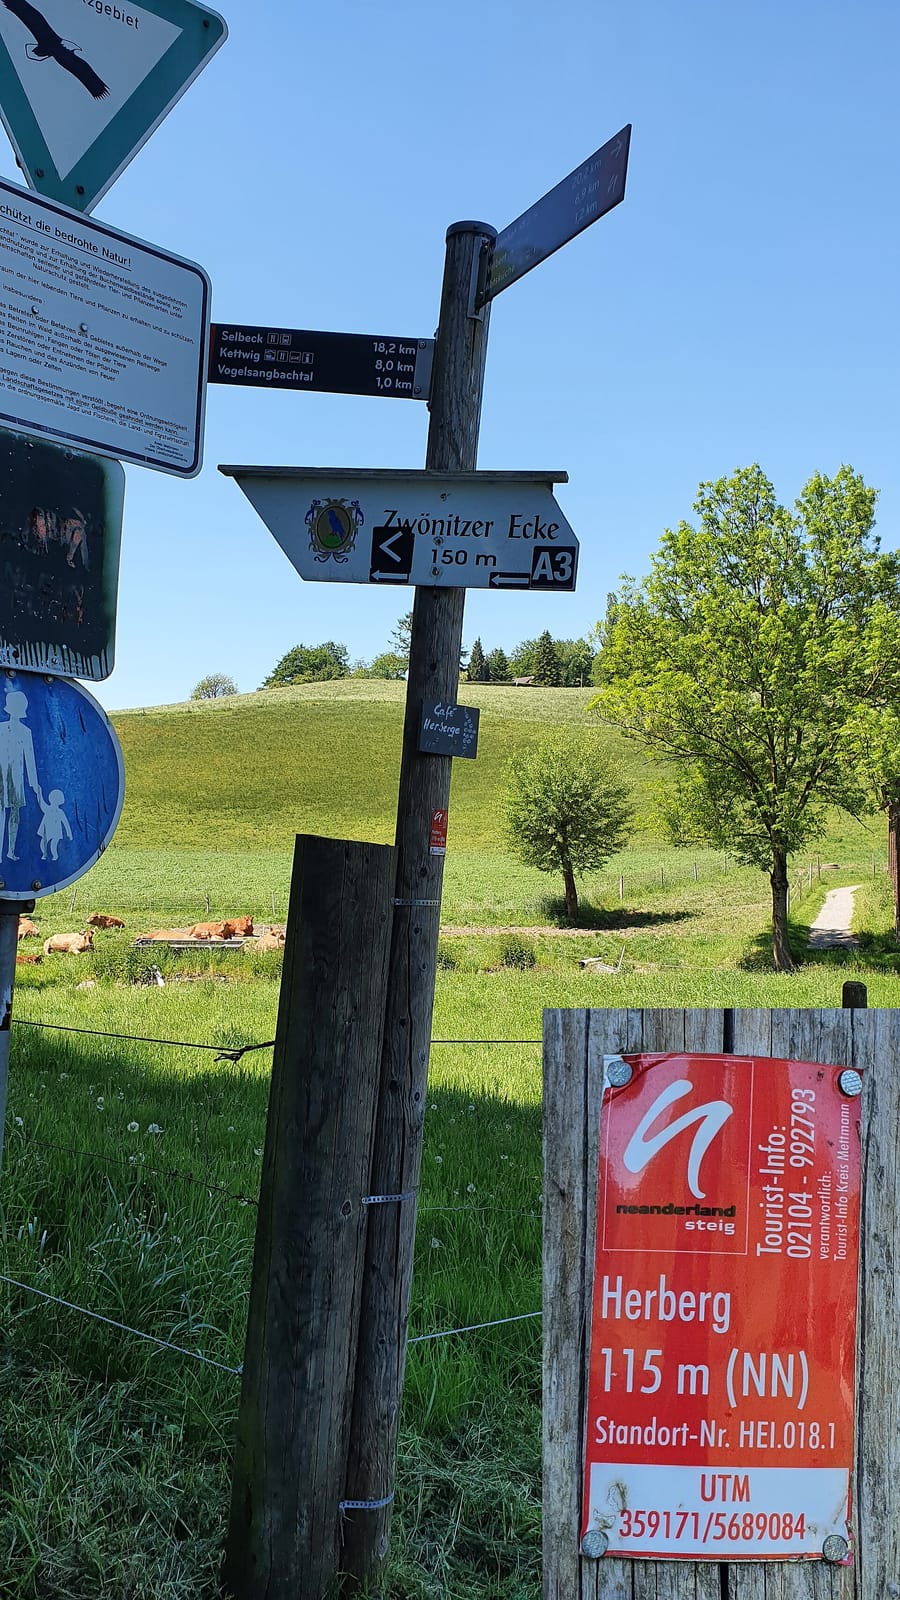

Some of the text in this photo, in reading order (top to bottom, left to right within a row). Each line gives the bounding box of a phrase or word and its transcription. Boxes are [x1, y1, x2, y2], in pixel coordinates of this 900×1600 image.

[0, 202, 131, 267] chützt die bedrohte Natur!
[36, 249, 47, 258] und
[80, 260, 90, 269] und
[32, 262, 66, 280] Naturschutz
[16, 270, 26, 280] der
[69, 291, 83, 302] Tiere
[84, 297, 95, 306] und
[121, 291, 131, 299] und
[7, 312, 26, 325] Reiten
[8, 304, 32, 318] Betreten
[35, 314, 48, 324] oder
[6, 339, 32, 353] Rauchen
[37, 341, 50, 351] oder
[70, 344, 82, 353] oder
[221, 330, 416, 355] Selbeck 18,2 km
[28, 356, 41, 365] oder
[219, 347, 414, 373] Kettwig 8,0 km
[217, 364, 412, 390] Vogelsangbachtal 1,0 km
[382, 509, 560, 540] Zwönitzer Ecke
[431, 549, 498, 567] 150 m
[532, 551, 573, 582] A3
[789, 1088, 816, 1168] 992793
[756, 1124, 787, 1257] Tourist-Info:
[833, 1104, 850, 1261] Tourist-Info Kreis Mettmann
[616, 1203, 736, 1218] neanderland
[817, 1170, 832, 1260] verantwortlich:
[685, 1219, 735, 1235] steig
[787, 1192, 813, 1259] 02104
[601, 1274, 731, 1334] Herberg
[601, 1347, 809, 1410] 115 m (NN)
[595, 1416, 836, 1449] Standort-Nr. HEI.018.1
[700, 1473, 751, 1503] UTM
[619, 1509, 806, 1543] 359171/5689084
